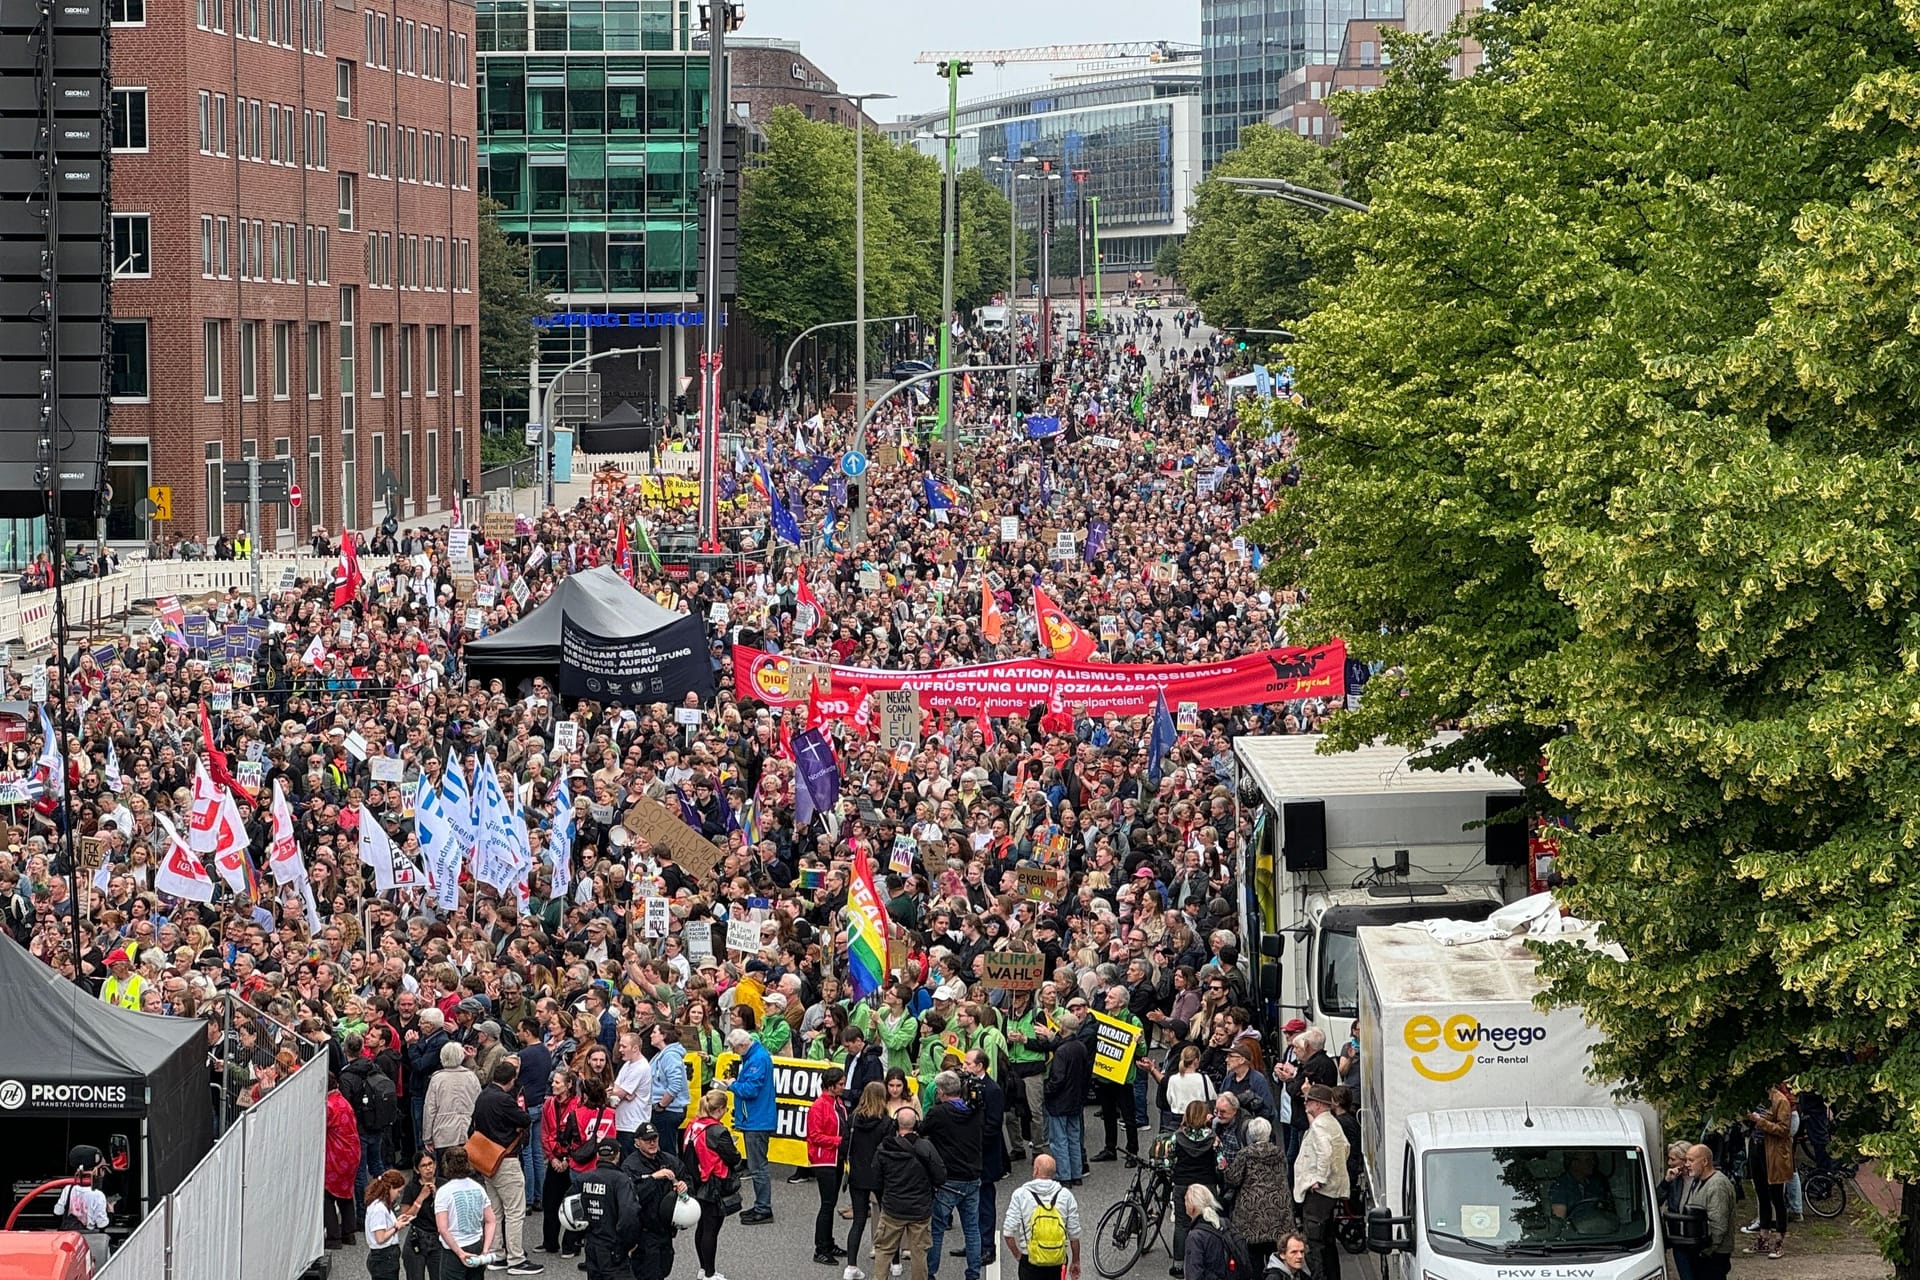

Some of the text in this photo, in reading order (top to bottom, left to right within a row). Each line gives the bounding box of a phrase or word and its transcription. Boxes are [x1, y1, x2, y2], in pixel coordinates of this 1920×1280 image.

[619, 646, 657, 658] GEGEN
[619, 647, 692, 667] AUFRÜSTUNG
[763, 674, 788, 685] DIDF
[900, 680, 1012, 692] AUFRÜSTUNG
[1015, 683, 1049, 692] UND
[886, 691, 912, 704] NEVER
[886, 704, 913, 713] GONNA
[889, 722, 912, 736] EU
[84, 842, 100, 854] FCK
[986, 967, 1033, 980] WAHL
[1457, 1023, 1547, 1046] wheego
[1477, 1055, 1529, 1065] Car Rental
[31, 1084, 127, 1102] PROTONES
[583, 1182, 606, 1195] POLIZEI
[1497, 1269, 1595, 1278] PKW & LKW
